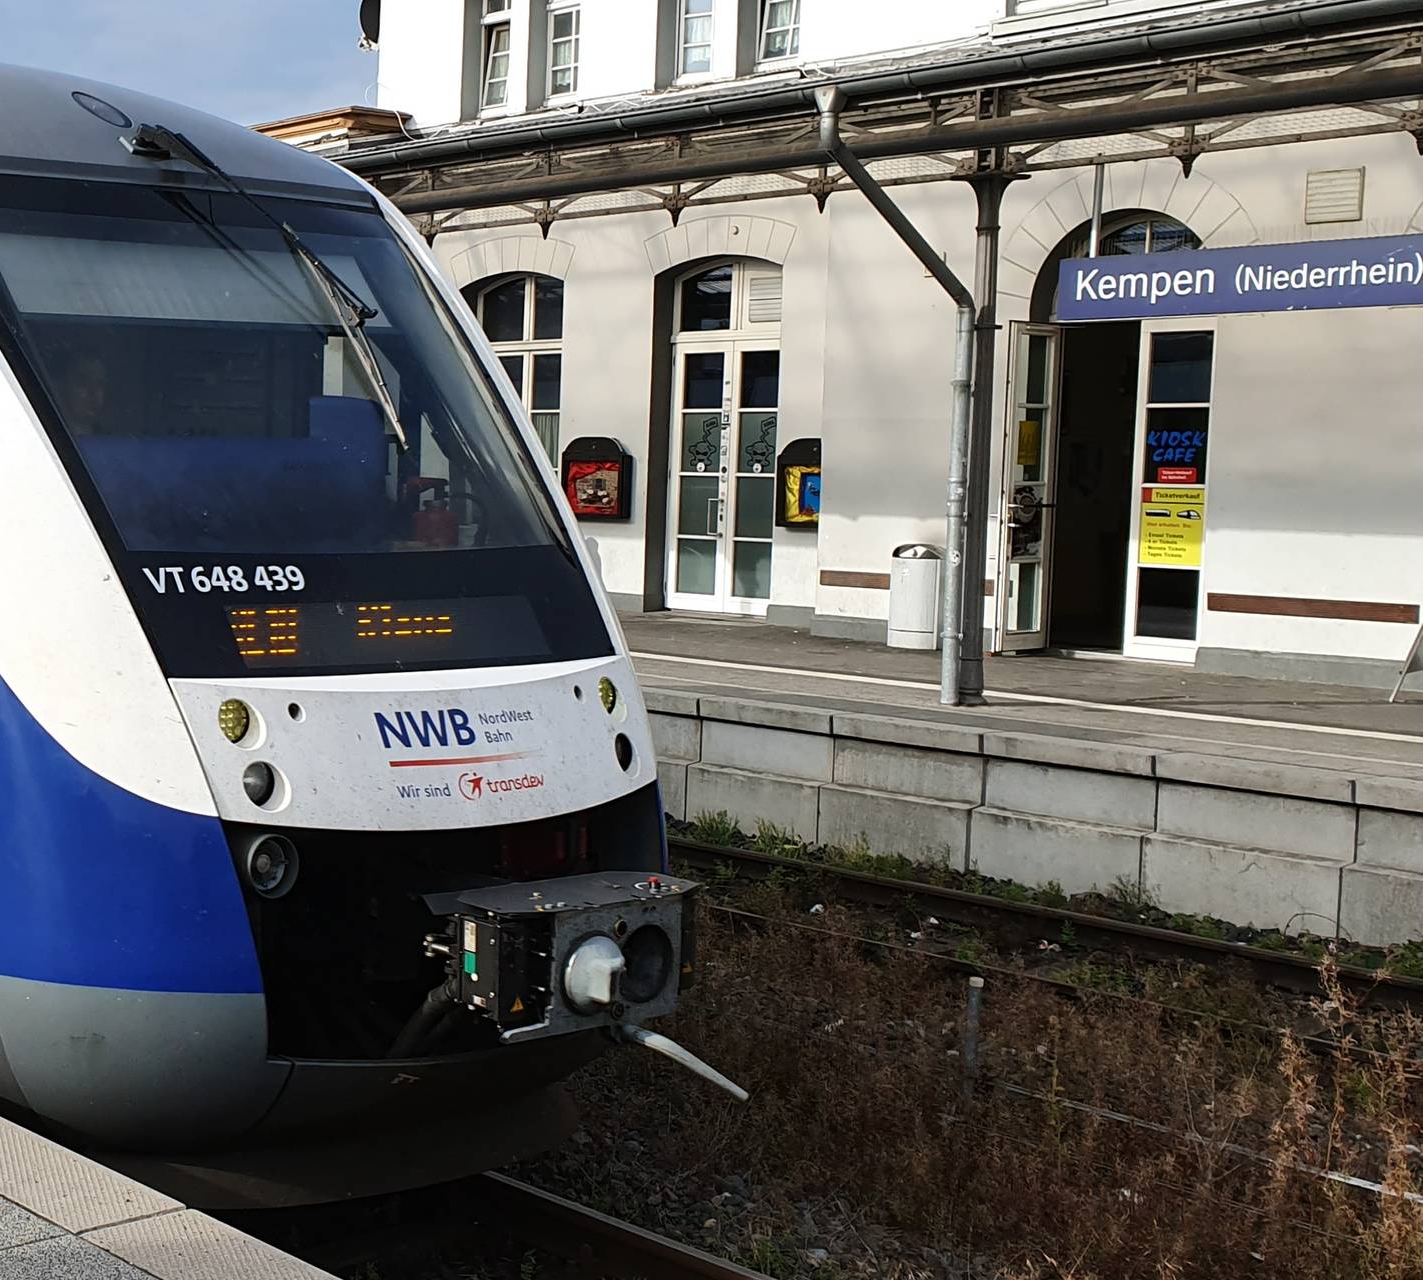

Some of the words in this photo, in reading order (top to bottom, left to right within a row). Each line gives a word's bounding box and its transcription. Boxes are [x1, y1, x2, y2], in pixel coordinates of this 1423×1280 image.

[1075, 268, 1215, 304] Kempen
[1235, 252, 1423, 294] (Niederrhein)
[1147, 430, 1206, 447] KIOSK
[1152, 448, 1197, 462] CAFE
[143, 566, 185, 594] VT
[191, 565, 249, 593] 648
[254, 564, 306, 592] 439
[478, 709, 534, 726] NordWest
[374, 708, 476, 749] NWB
[484, 730, 514, 744] Bahn
[396, 785, 422, 799] Wir
[424, 783, 452, 798] sind
[486, 773, 545, 793] transdev
